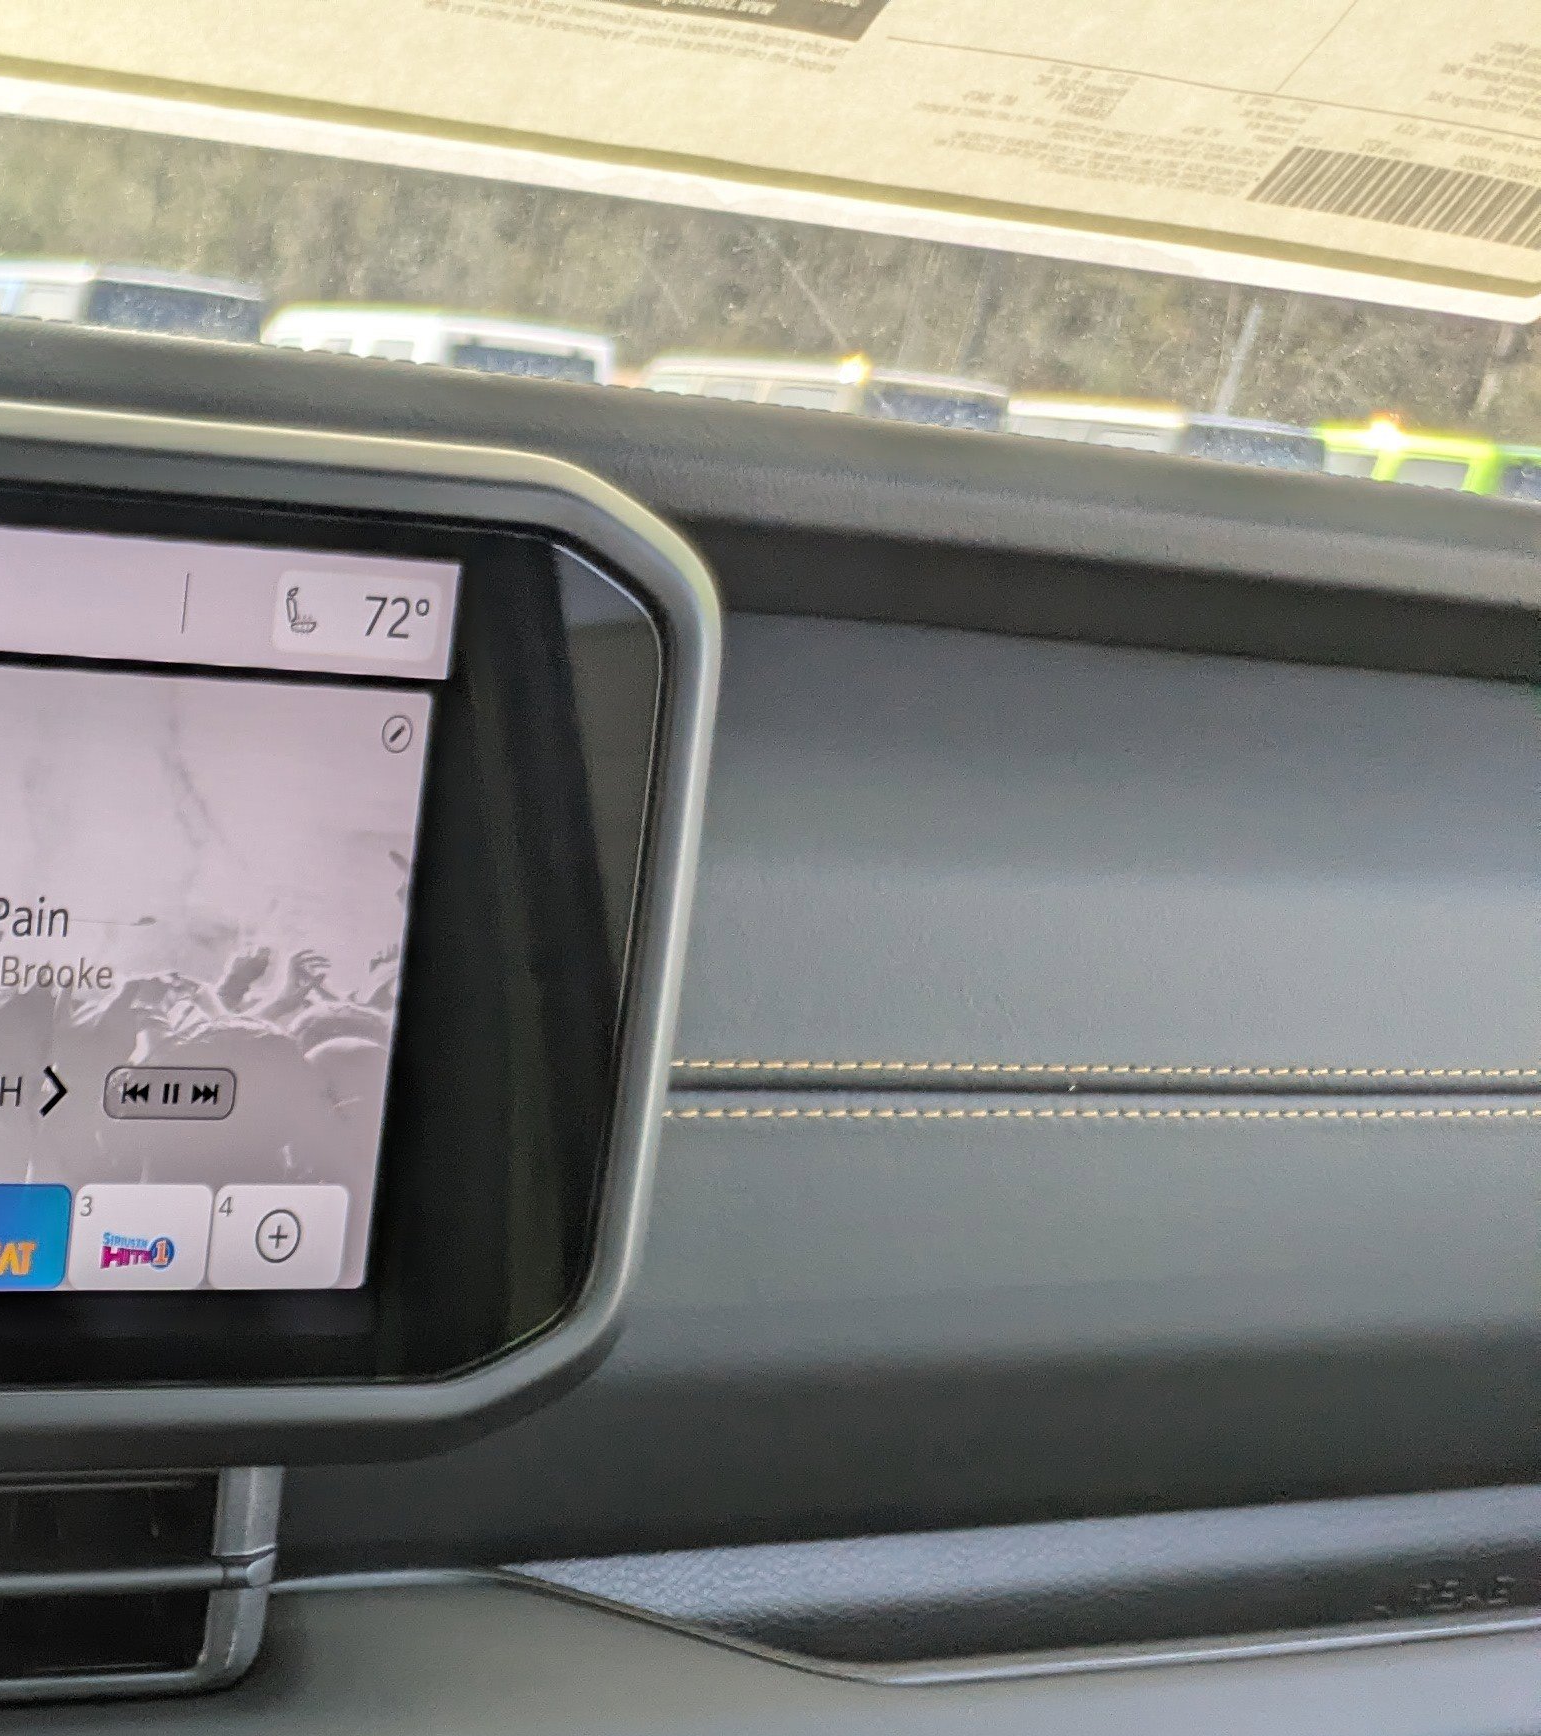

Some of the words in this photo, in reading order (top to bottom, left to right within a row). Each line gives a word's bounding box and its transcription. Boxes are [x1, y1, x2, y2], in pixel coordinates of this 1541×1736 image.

[363, 595, 431, 639] 72°
[0, 956, 113, 989] Brooke
[80, 1196, 93, 1217] 3
[218, 1196, 233, 1217] 4
[153, 1240, 168, 1265] 1
